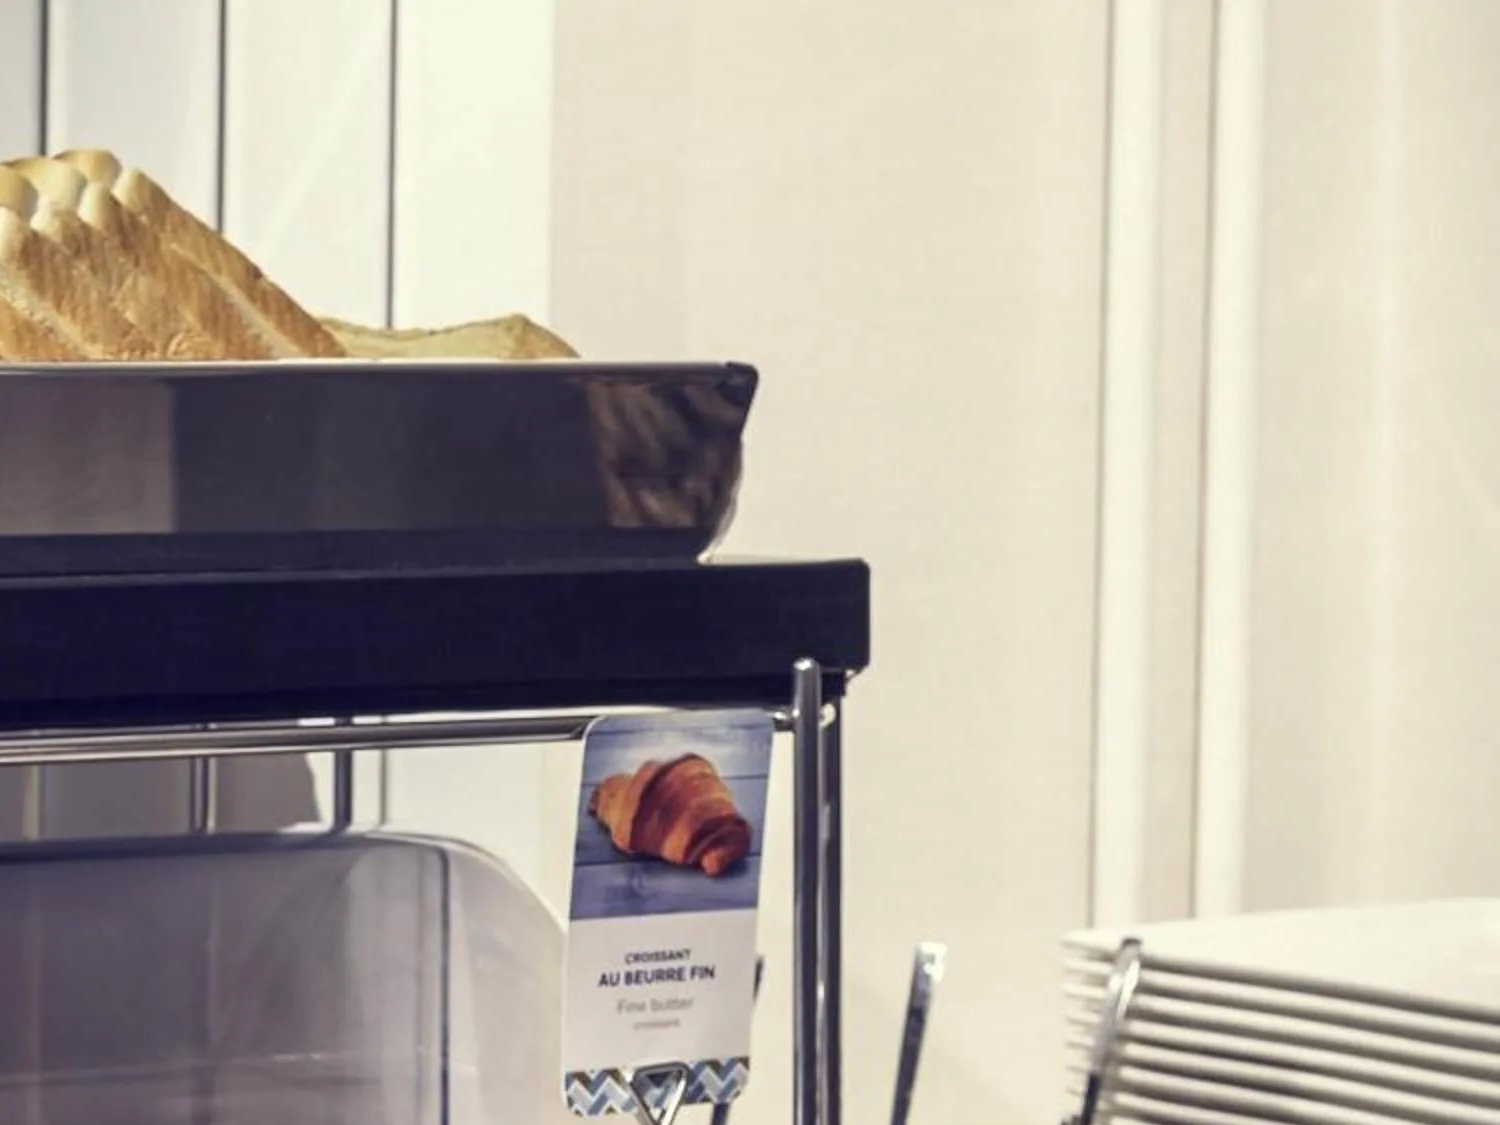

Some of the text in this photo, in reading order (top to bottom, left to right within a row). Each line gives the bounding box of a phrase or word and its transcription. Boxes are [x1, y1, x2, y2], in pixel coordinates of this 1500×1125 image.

[625, 949, 691, 964] CROISSANT
[599, 965, 715, 987] AU BEURRE FIN
[617, 998, 693, 1014] Fine butter
